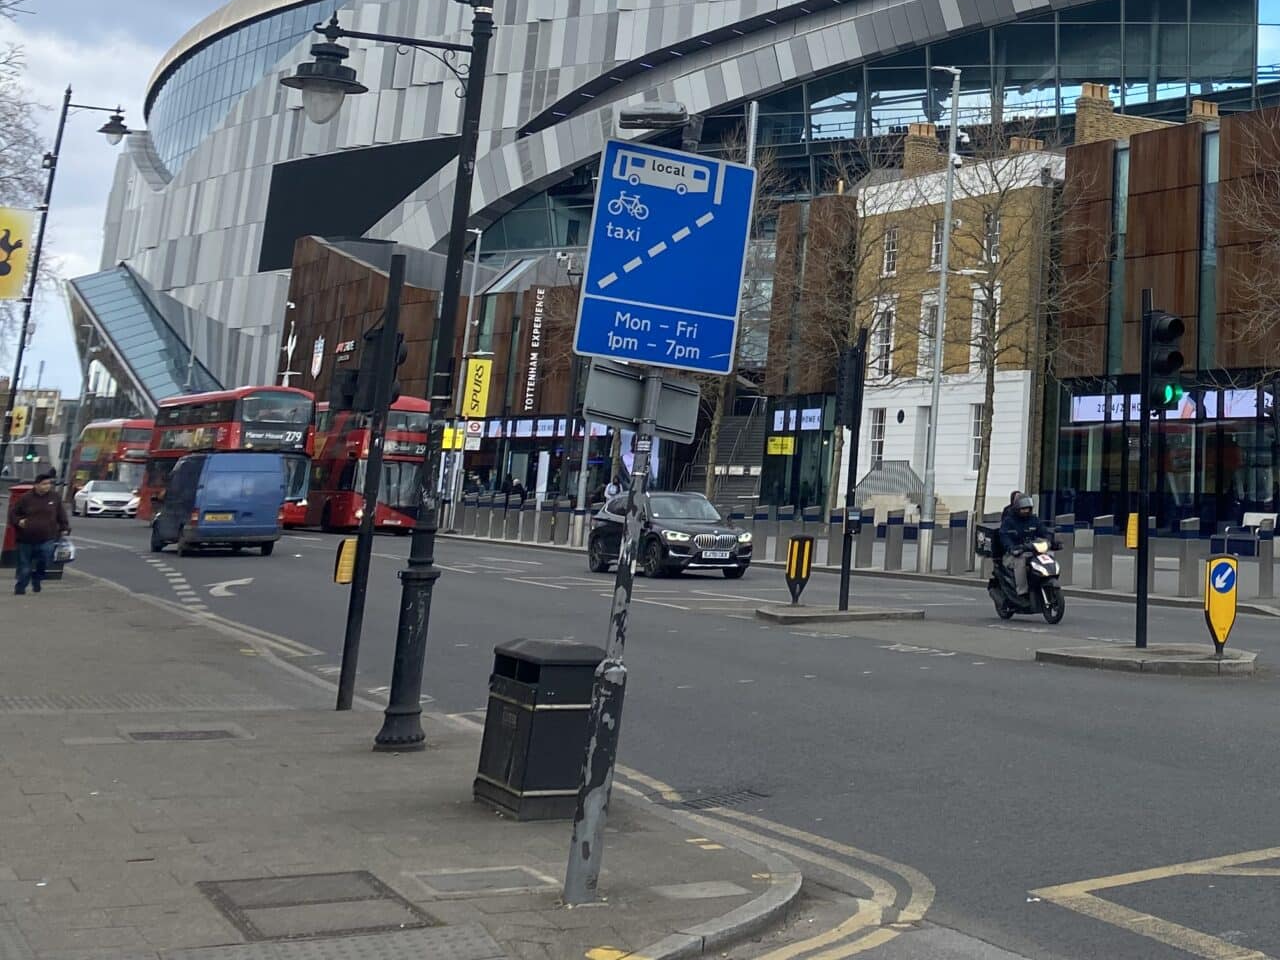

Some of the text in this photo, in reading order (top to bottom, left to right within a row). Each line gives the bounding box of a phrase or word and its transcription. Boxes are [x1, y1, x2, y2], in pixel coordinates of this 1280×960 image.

[651, 159, 686, 178] local
[606, 221, 641, 242] taxi
[614, 311, 651, 332] Mon
[676, 321, 699, 339] Fri
[524, 288, 546, 411] TOTTENHAM EXPERIENCE
[607, 331, 638, 351] 1pm
[665, 340, 701, 360] 7pm
[470, 364, 485, 413] SPURS
[285, 431, 303, 442] 279
